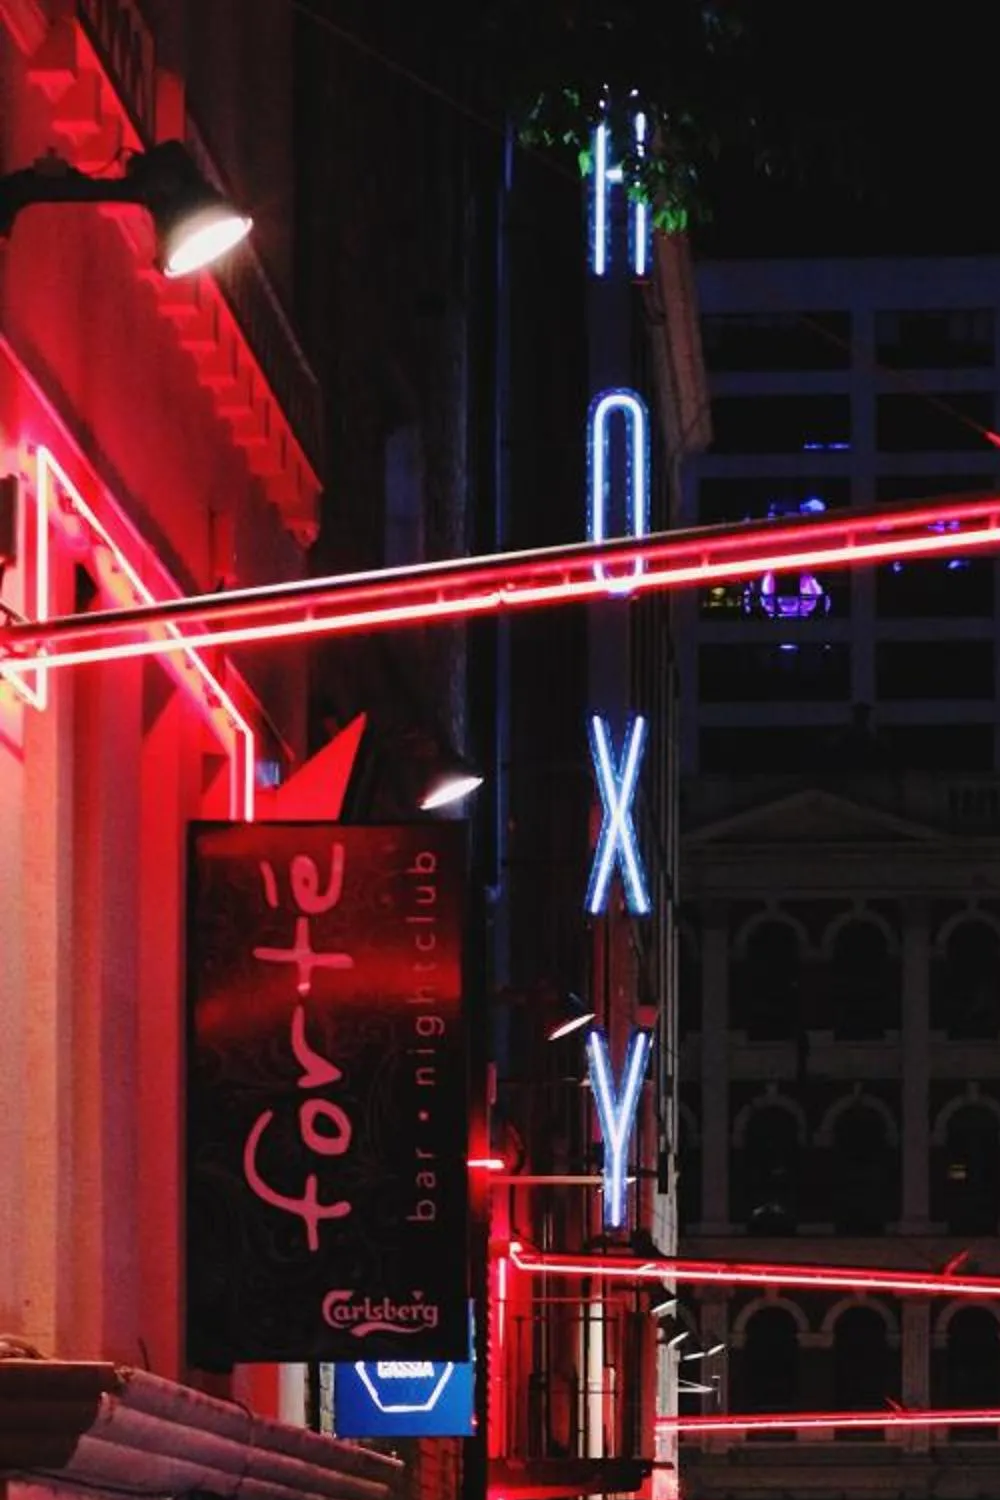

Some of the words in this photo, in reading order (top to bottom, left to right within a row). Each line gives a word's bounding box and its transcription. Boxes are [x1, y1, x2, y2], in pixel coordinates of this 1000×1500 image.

[405, 850, 446, 1086] nightclub
[405, 1147, 437, 1222] bar
[321, 1289, 439, 1337] Carlsberg
